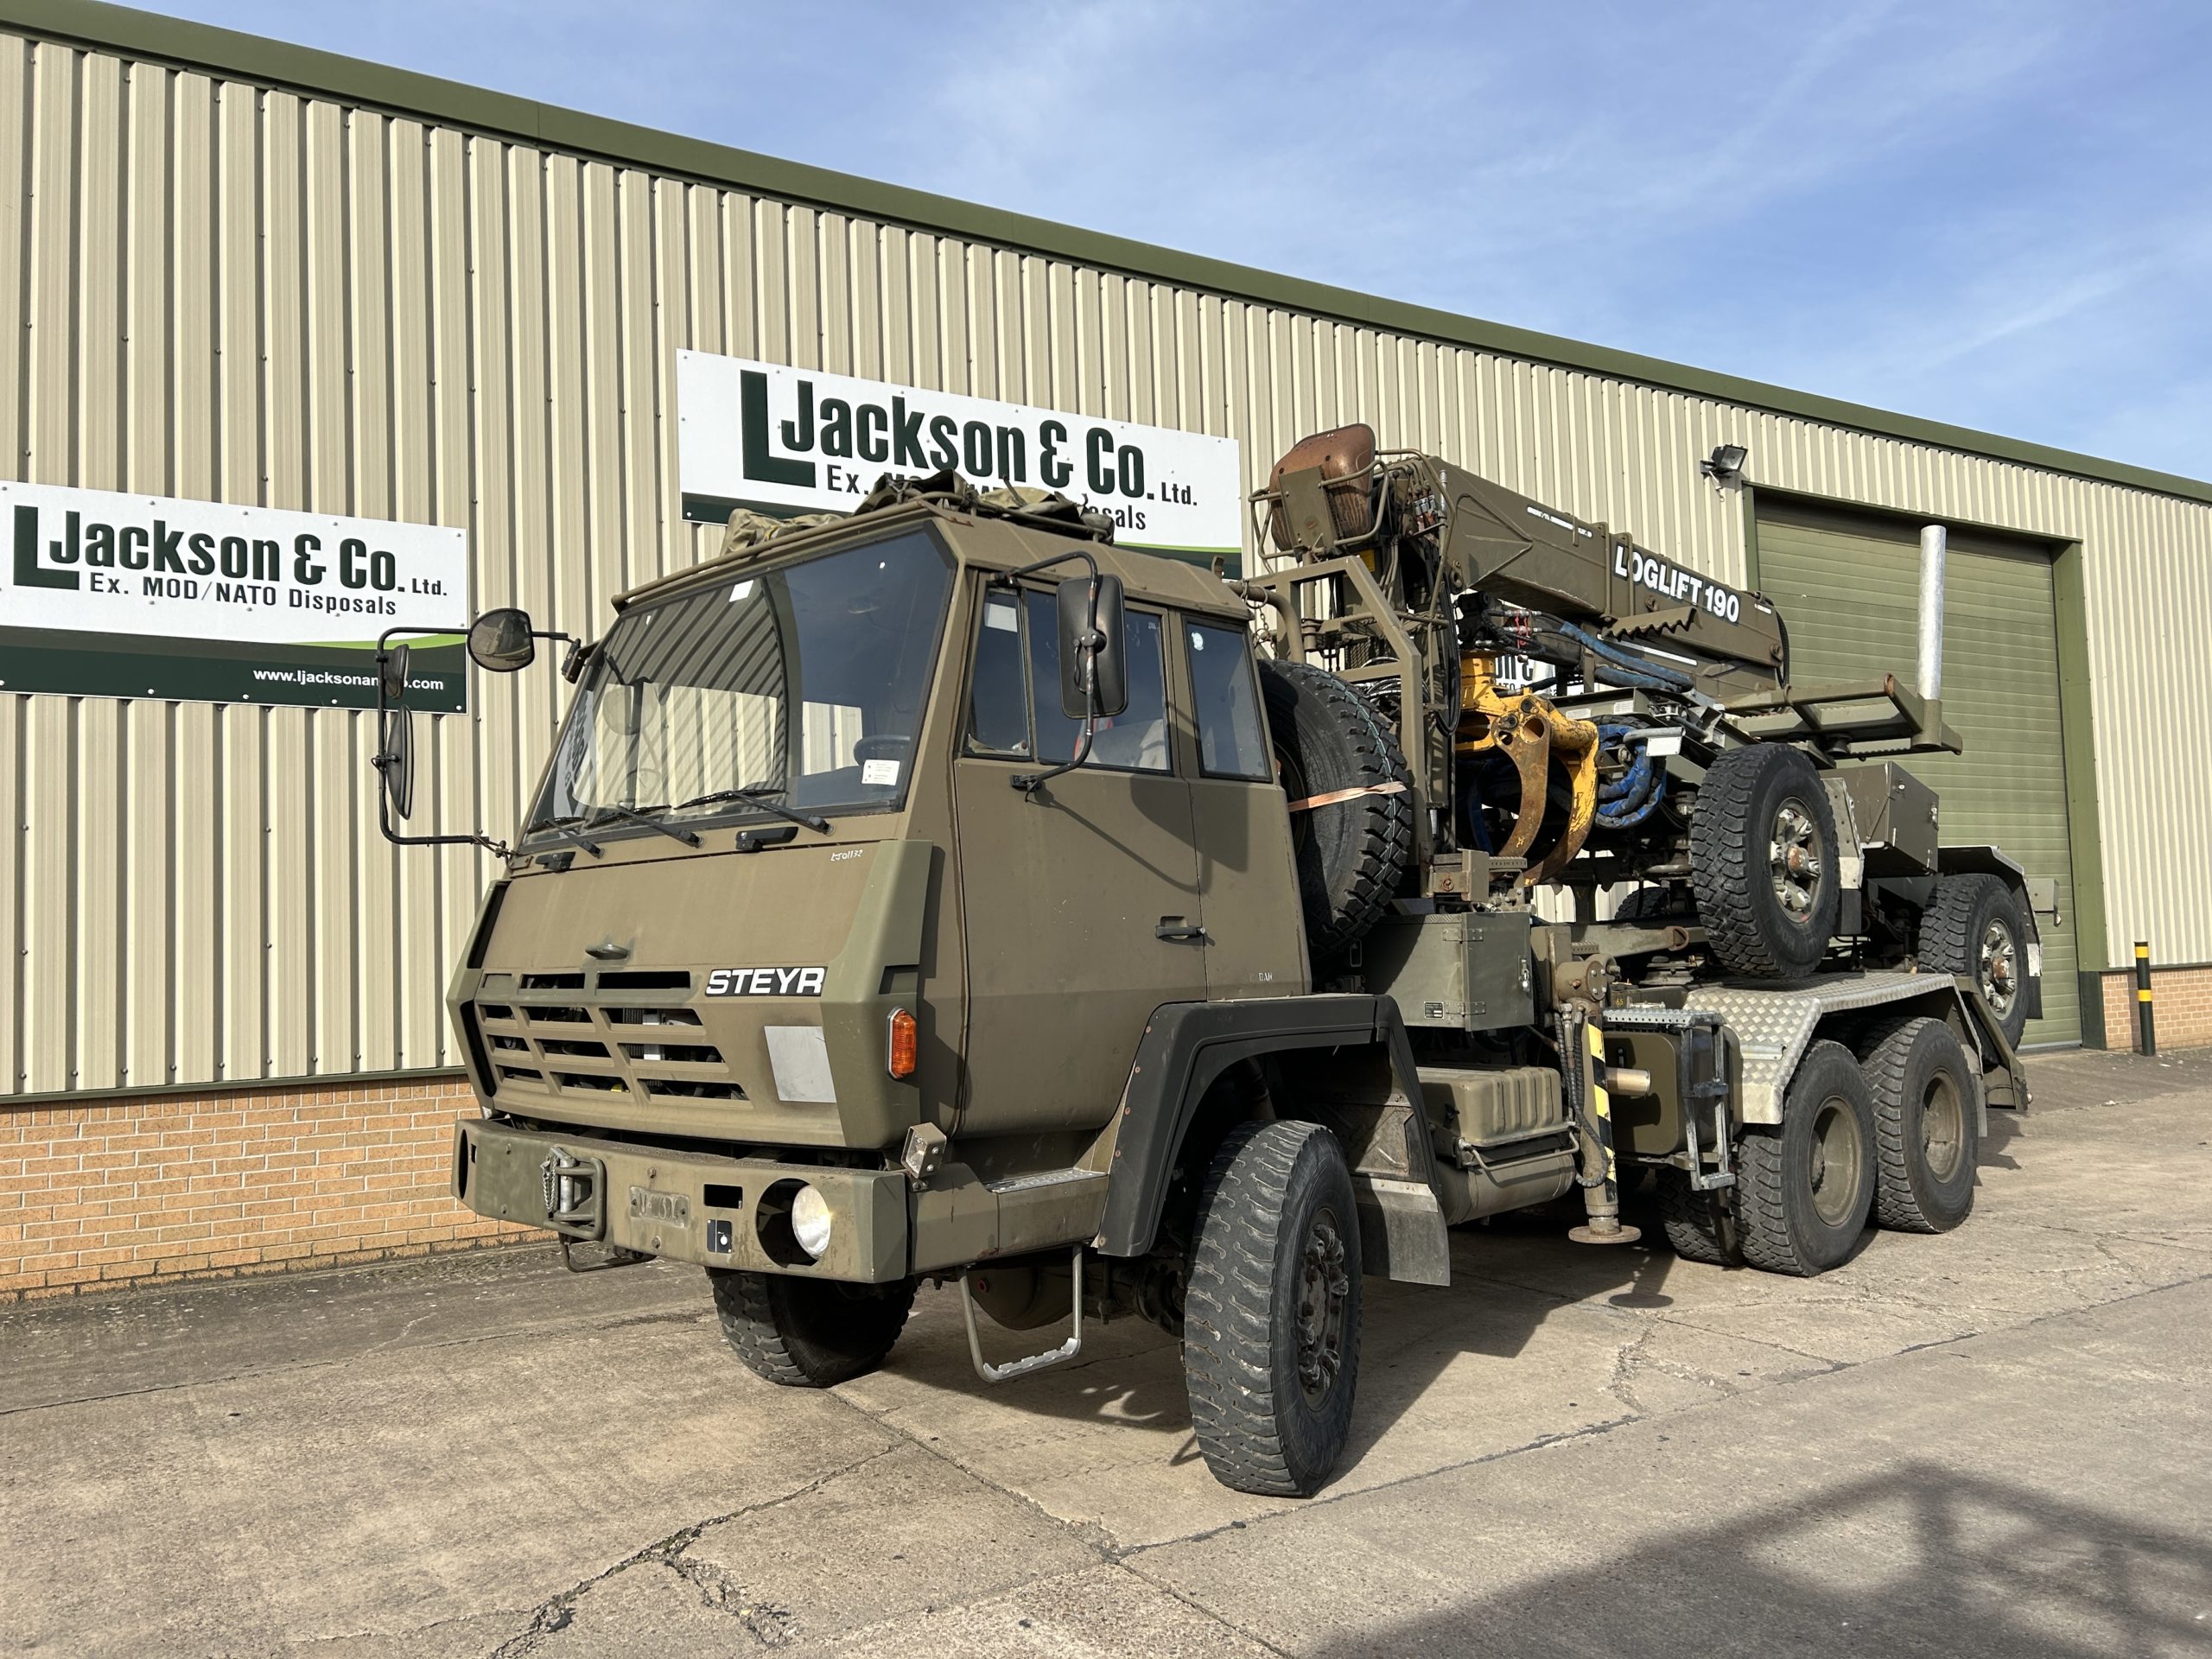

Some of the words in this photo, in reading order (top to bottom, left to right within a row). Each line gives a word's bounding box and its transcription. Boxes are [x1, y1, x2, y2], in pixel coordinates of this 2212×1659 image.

[827, 464, 869, 495] Ex.
[1039, 419, 1074, 487] &
[1086, 426, 1154, 500] Co.
[1161, 481, 1198, 506] Ltd.
[294, 533, 327, 585] &
[339, 537, 405, 593] Co.
[411, 577, 448, 597] Ltd.
[1615, 545, 1703, 606] LOGLIFT
[1705, 585, 1739, 623] 190
[90, 572, 129, 594] Ex.
[143, 575, 276, 607] MOD/NATO
[289, 589, 397, 616] Disposals
[253, 670, 443, 690] www.ljacksonan.com
[706, 967, 825, 995] STEYR
